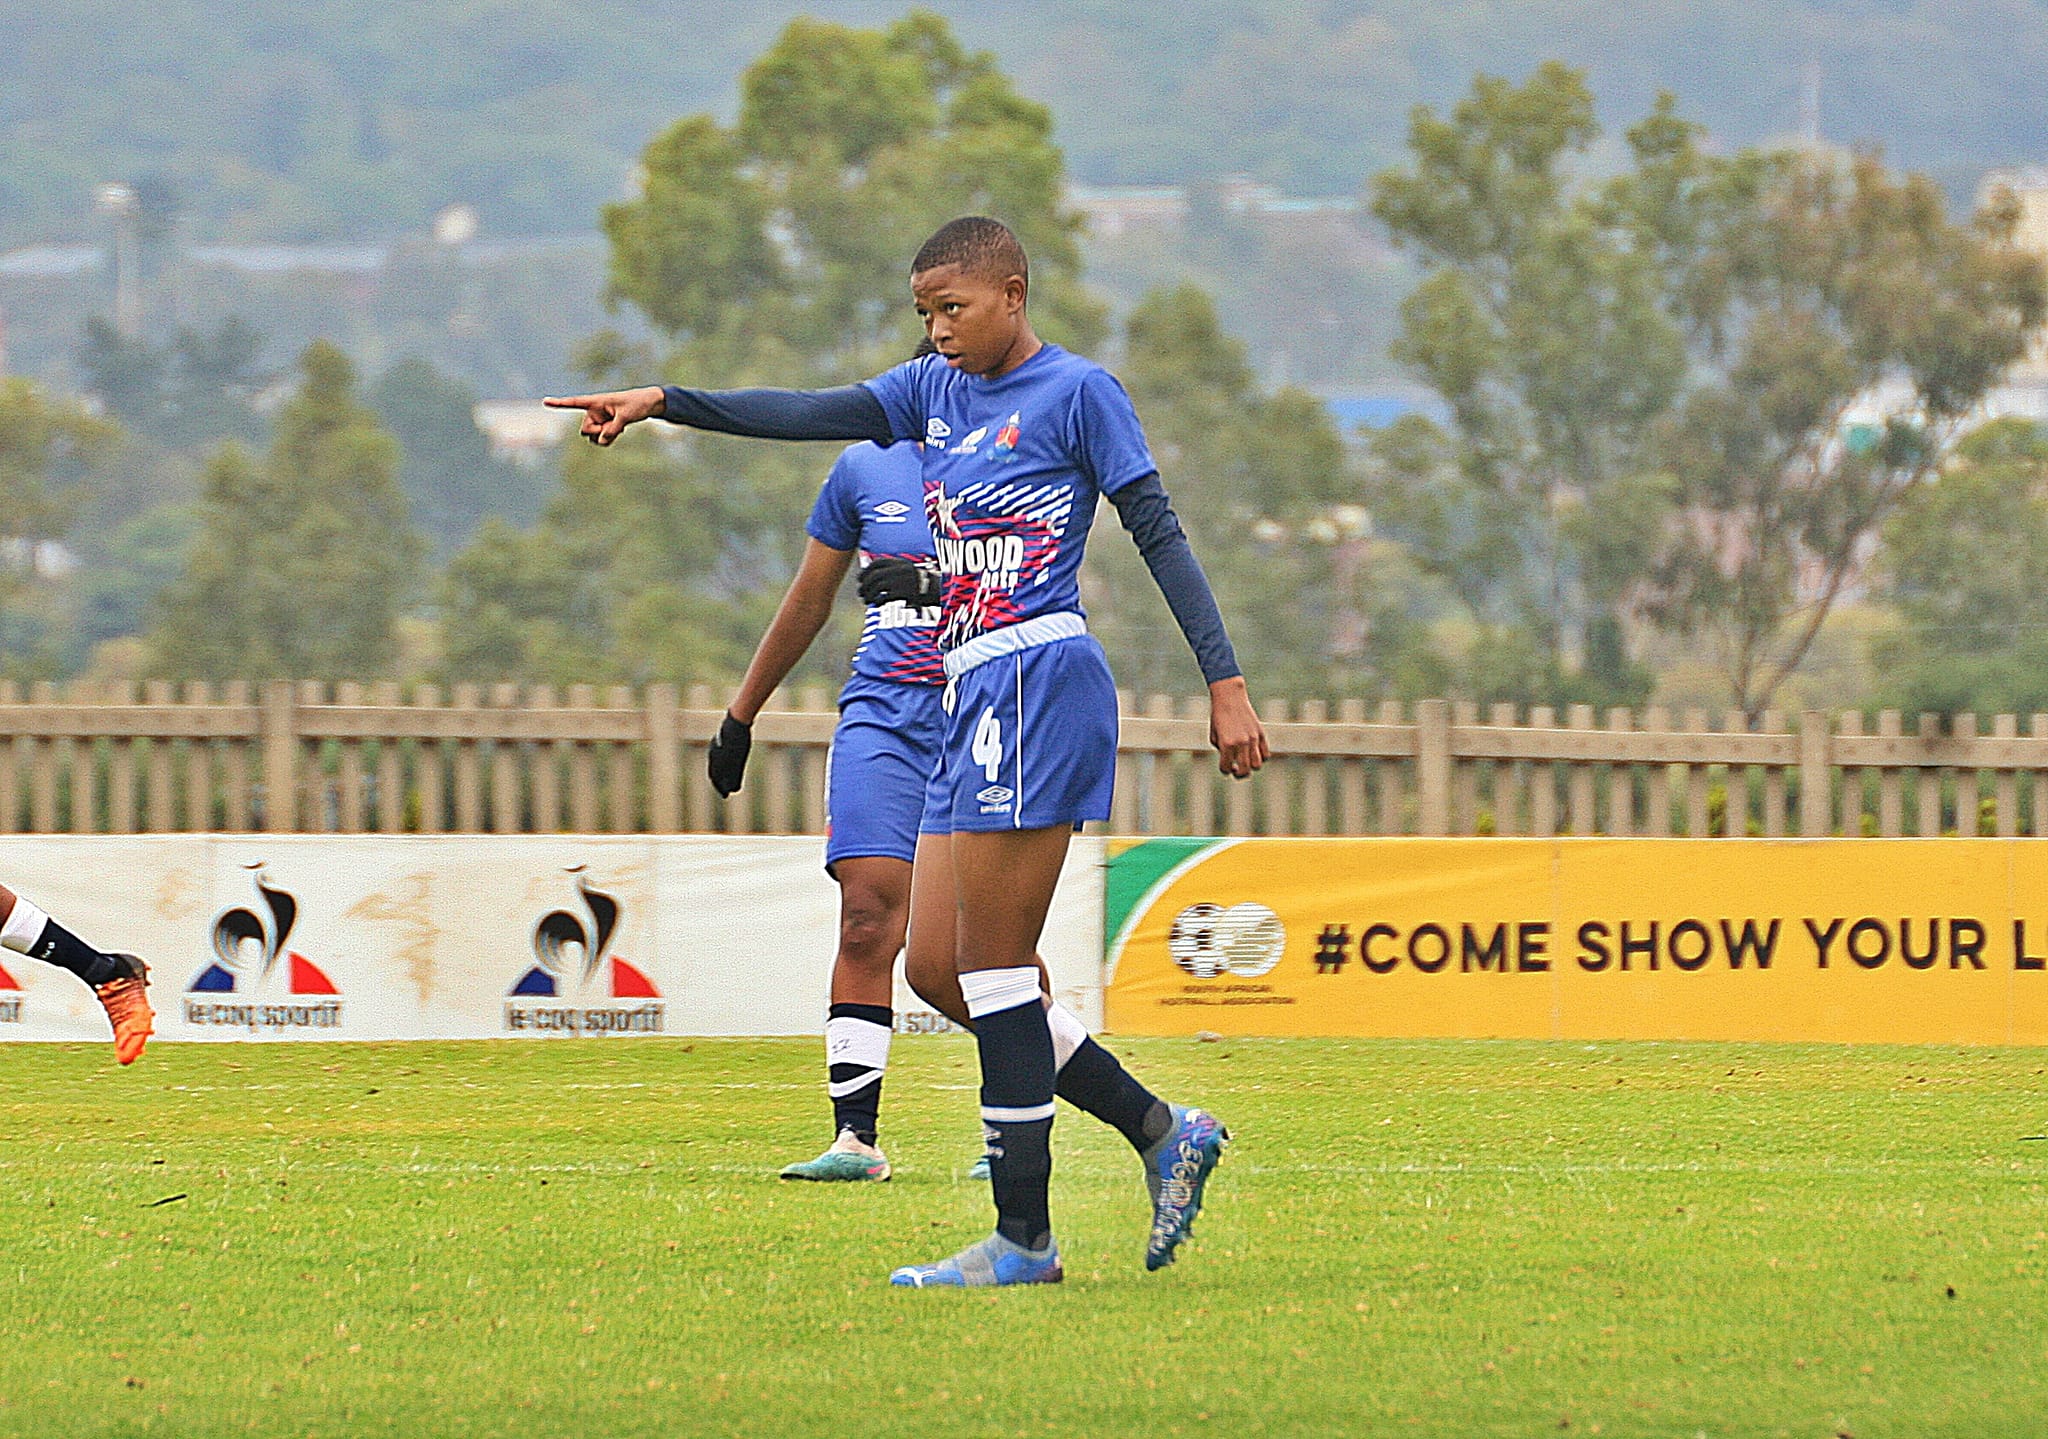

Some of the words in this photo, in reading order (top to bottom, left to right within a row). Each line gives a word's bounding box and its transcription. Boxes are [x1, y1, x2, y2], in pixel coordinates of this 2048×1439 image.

[972, 706, 1002, 782] 4
[1315, 922, 1551, 975] #COME
[1577, 917, 1782, 973] SHOW
[1803, 917, 1987, 971] YOUR
[265, 1000, 342, 1033] sportif
[584, 1003, 665, 1037] sportif
